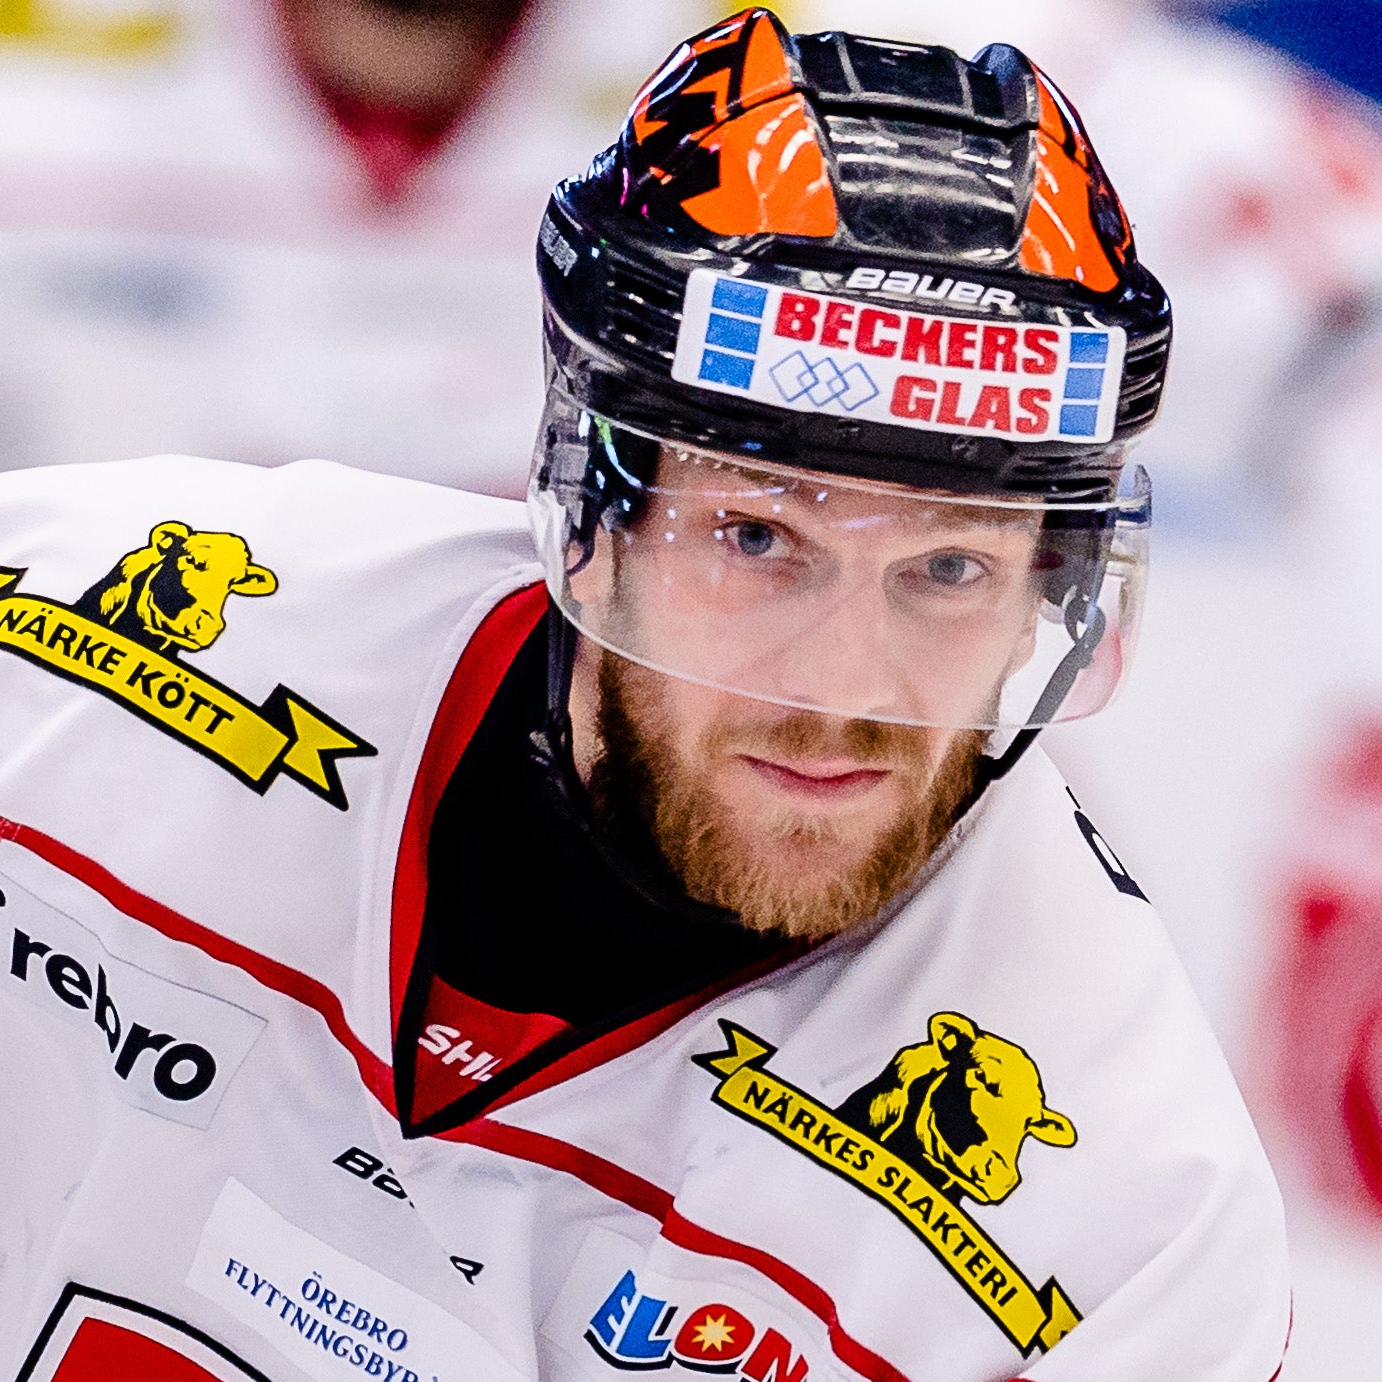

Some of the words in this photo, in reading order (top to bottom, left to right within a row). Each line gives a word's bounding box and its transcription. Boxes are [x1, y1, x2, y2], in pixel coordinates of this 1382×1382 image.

[773, 292, 1059, 375] BECKERS
[890, 375, 1052, 434] GLAS
[124, 660, 236, 736] KÖTT
[741, 1080, 876, 1172] NÄRKES
[876, 1166, 1019, 1308] SLAKTERI
[300, 1270, 410, 1352] ÖREBRO
